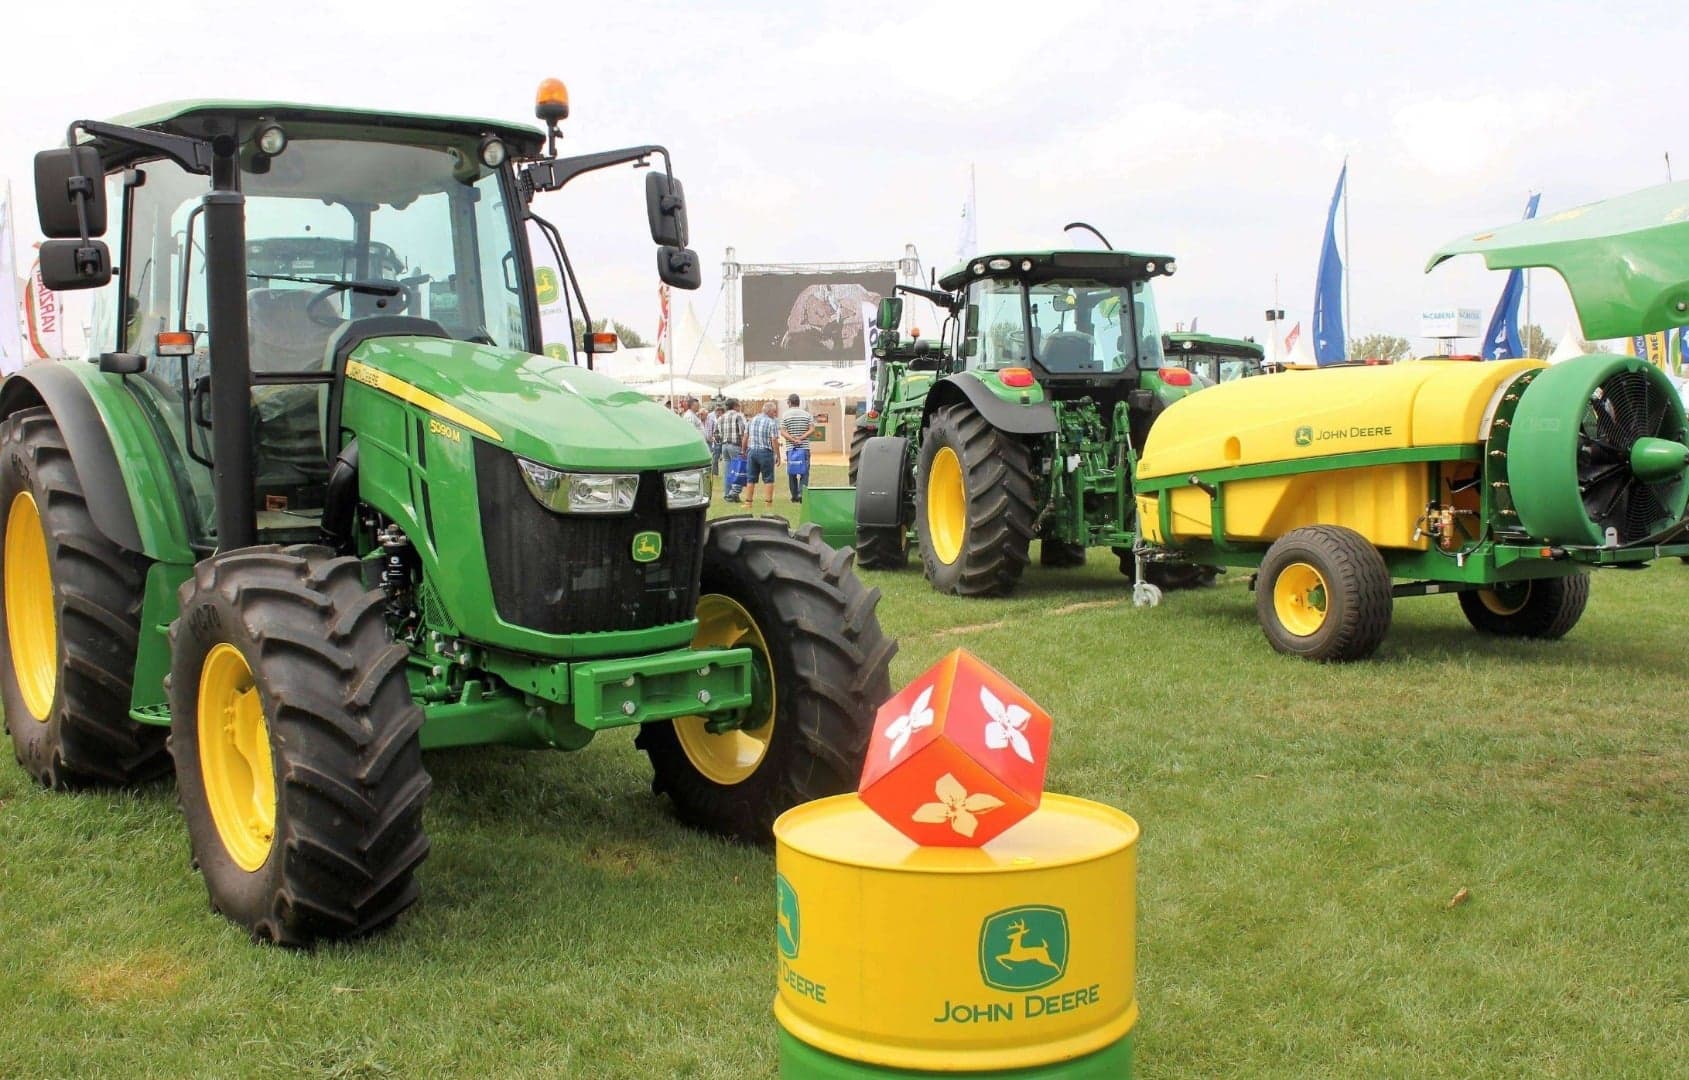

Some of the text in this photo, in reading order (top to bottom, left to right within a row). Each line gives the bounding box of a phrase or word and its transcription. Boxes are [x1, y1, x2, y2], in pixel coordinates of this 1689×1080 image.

[1316, 426, 1393, 441] JOHN DEERE
[783, 964, 827, 1004] DEERE
[934, 984, 1100, 1024] JOHN DEERE
